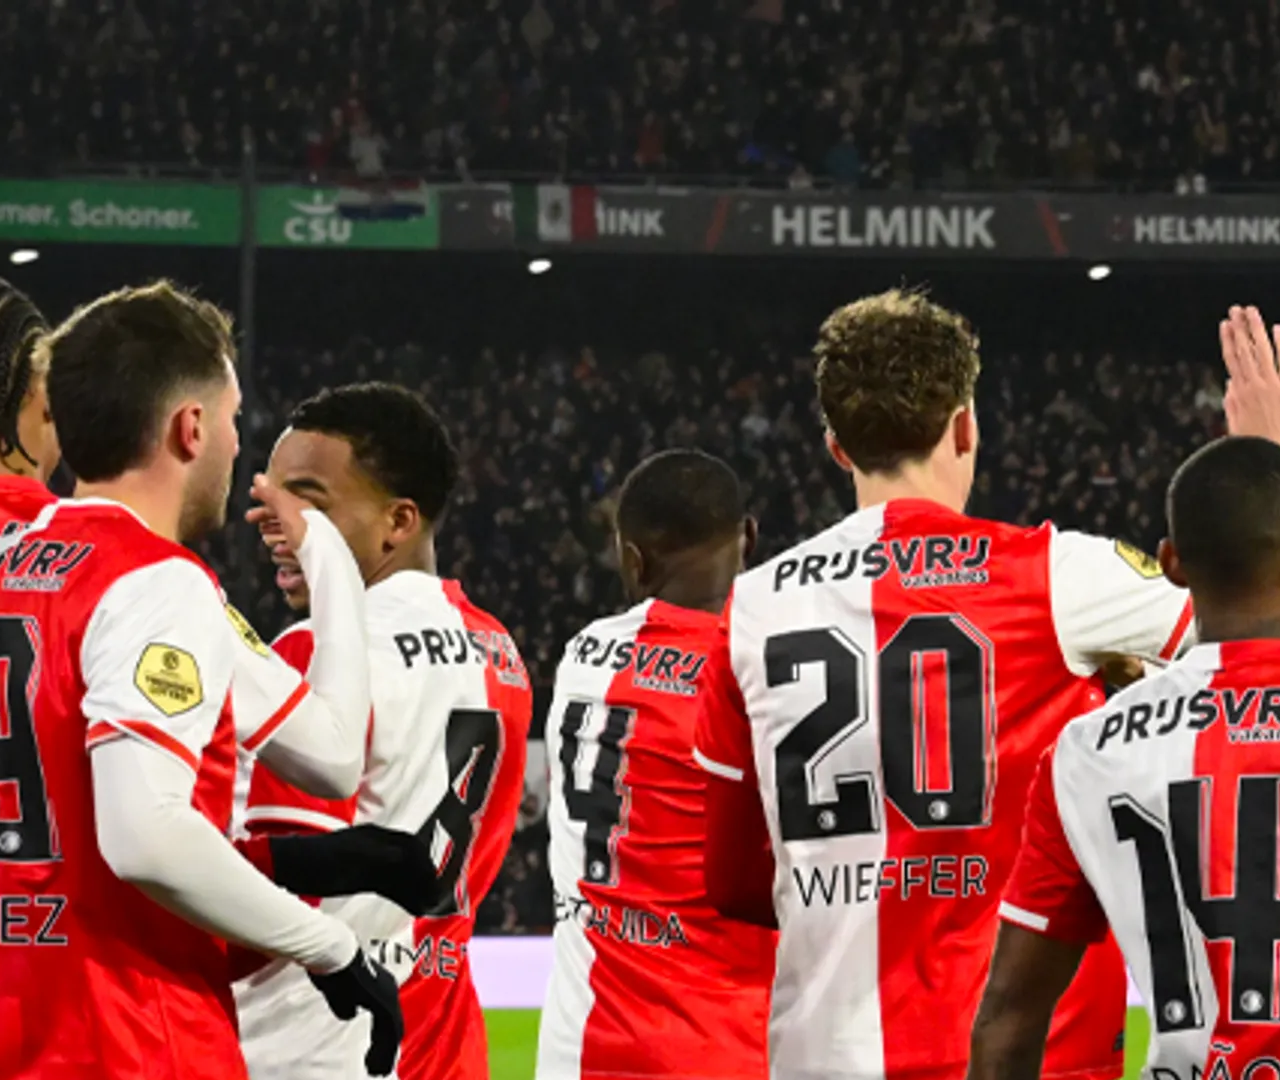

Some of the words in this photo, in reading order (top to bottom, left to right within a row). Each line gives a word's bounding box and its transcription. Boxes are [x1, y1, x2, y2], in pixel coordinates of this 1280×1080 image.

[283, 216, 354, 244] CSU
[772, 206, 996, 247] HELMINK
[764, 613, 996, 842] 20
[558, 702, 636, 887] 4
[793, 856, 989, 907] WIEFFER
